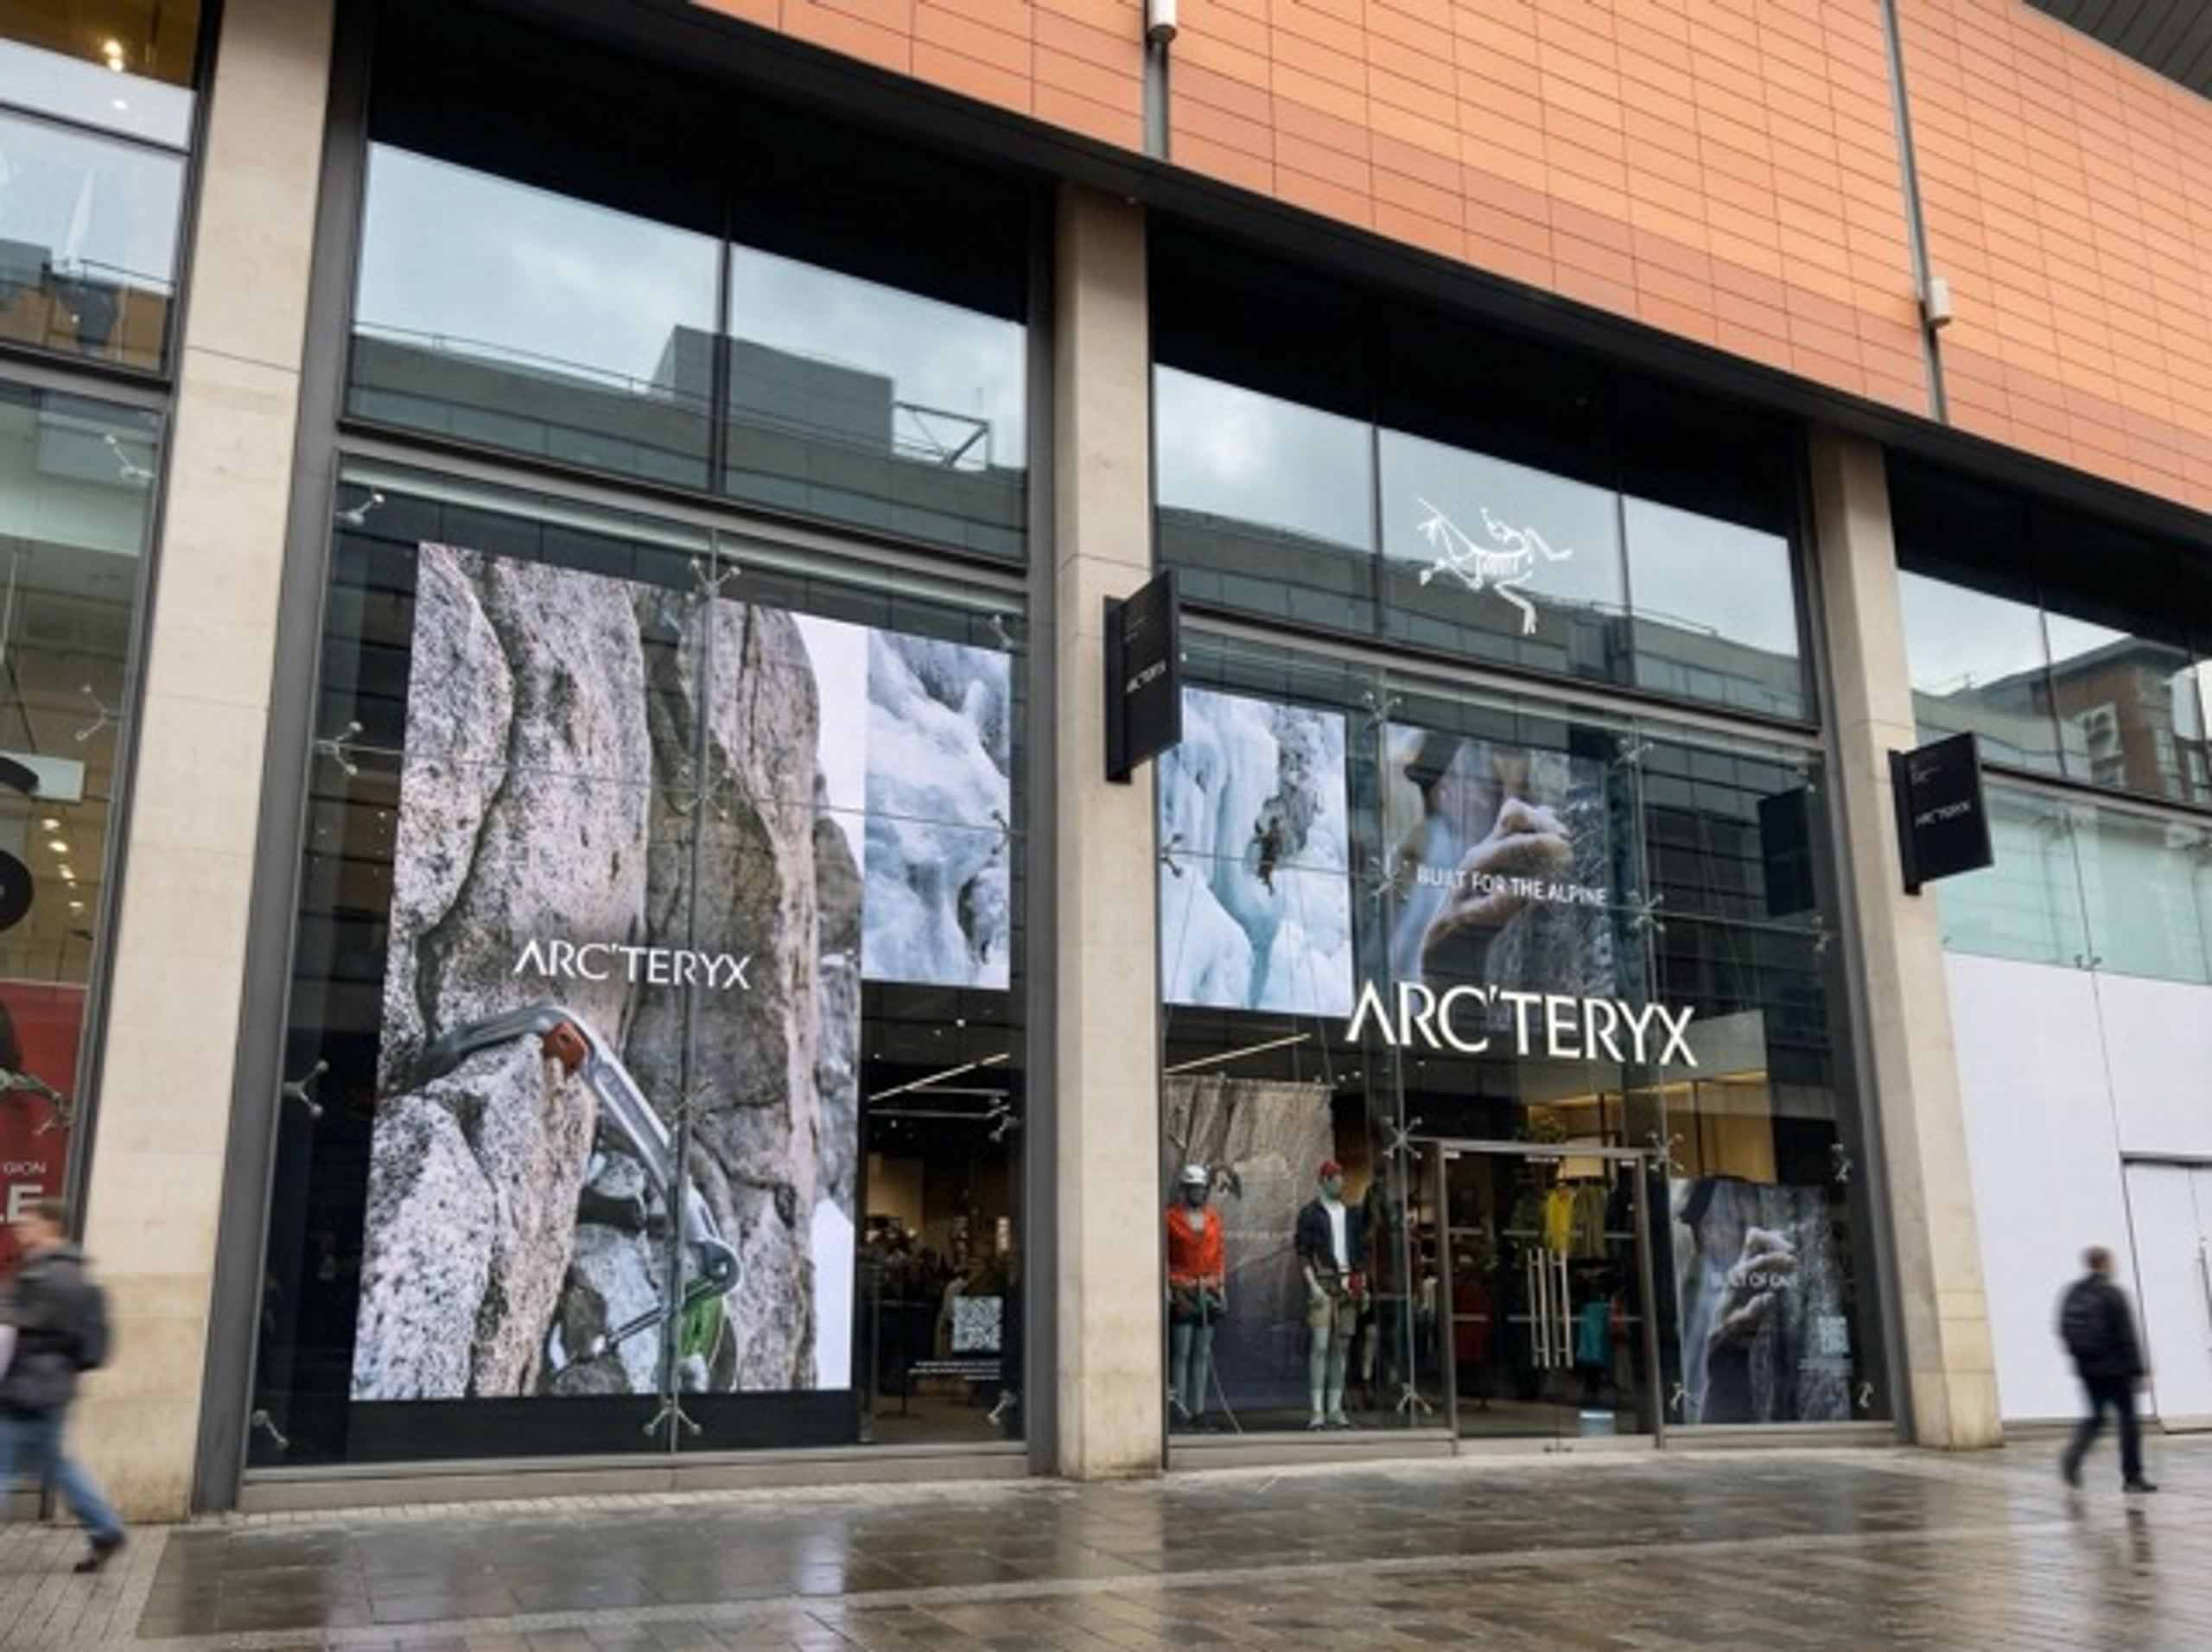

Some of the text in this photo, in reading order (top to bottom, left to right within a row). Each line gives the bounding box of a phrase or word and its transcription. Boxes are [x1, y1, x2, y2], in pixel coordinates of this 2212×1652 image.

[1471, 870, 1506, 893] FOR
[1510, 876, 1546, 899] THE
[1548, 883, 1609, 906] ALPINE
[513, 938, 752, 990] ARC'TERYX
[1344, 977, 1699, 1067] ARC'TERYX
[0, 1160, 47, 1174] GION
[0, 1184, 43, 1224] E
